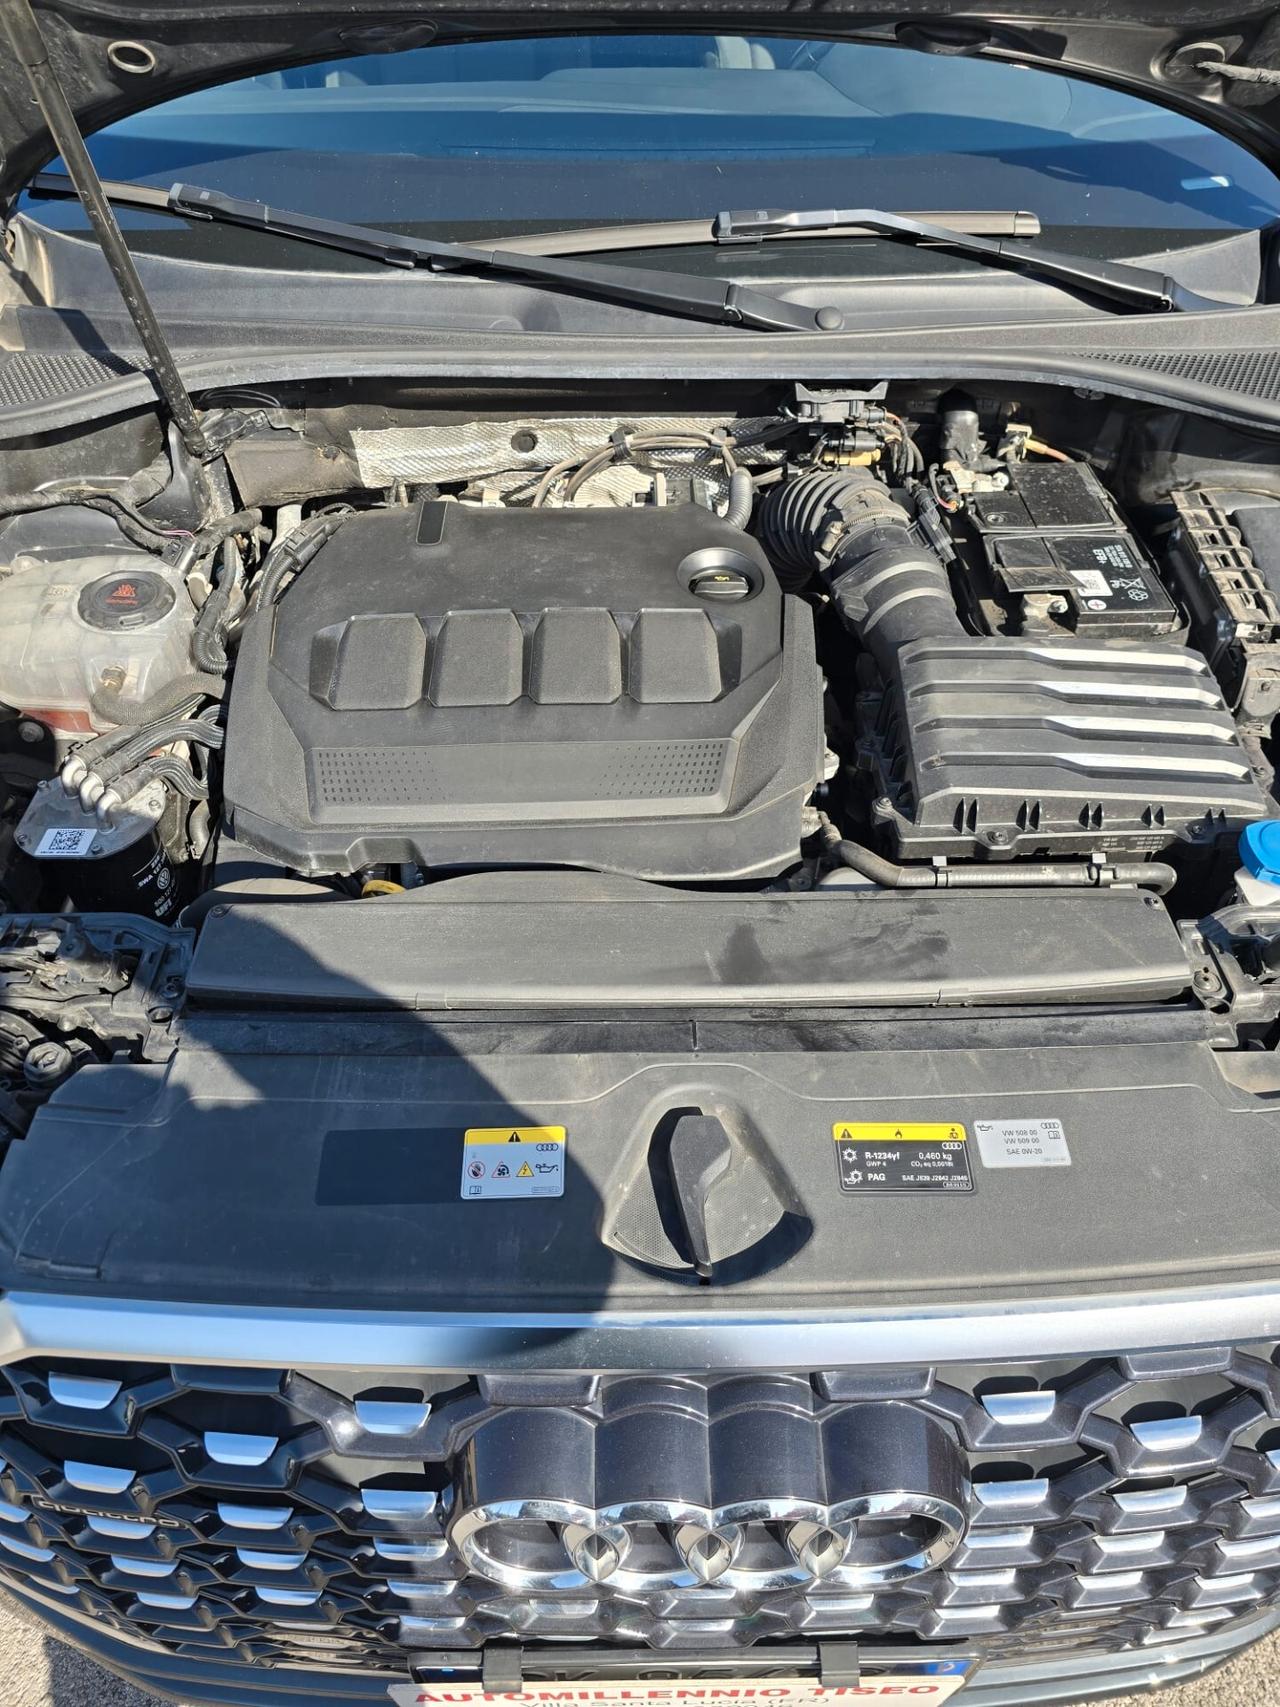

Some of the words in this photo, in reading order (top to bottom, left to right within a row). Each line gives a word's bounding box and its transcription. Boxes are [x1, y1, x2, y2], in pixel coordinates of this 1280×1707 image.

[865, 1151, 900, 1162] R-1234yf
[942, 1152, 952, 1161] kg
[868, 1173, 886, 1181] PAG
[416, 1689, 791, 1703] AUTOMILLENNIO
[808, 1685, 939, 1696] TISEO
